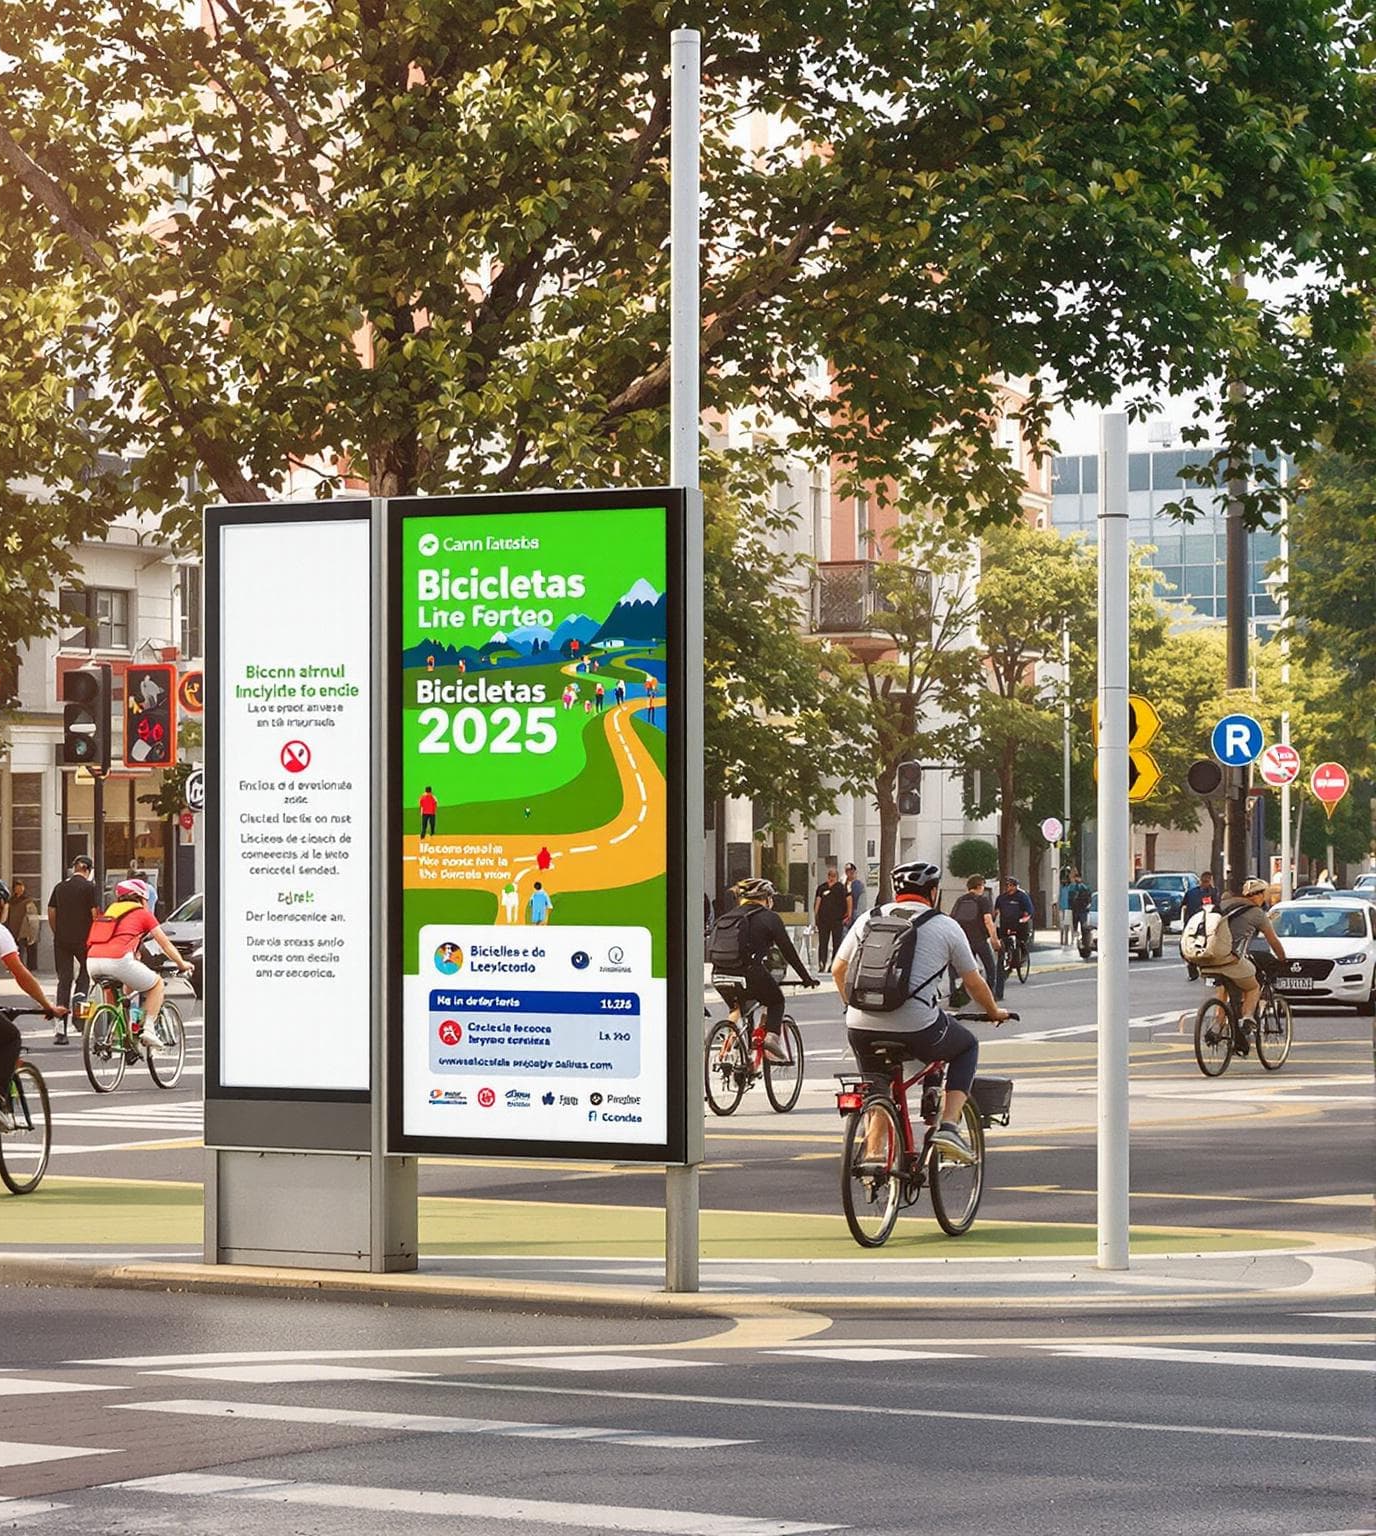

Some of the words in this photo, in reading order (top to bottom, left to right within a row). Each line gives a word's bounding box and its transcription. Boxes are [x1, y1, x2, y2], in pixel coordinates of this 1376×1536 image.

[418, 566, 586, 600] Bicicletas
[417, 677, 546, 703] Bicicletas
[418, 706, 558, 754] 2025
[1226, 724, 1252, 758] R
